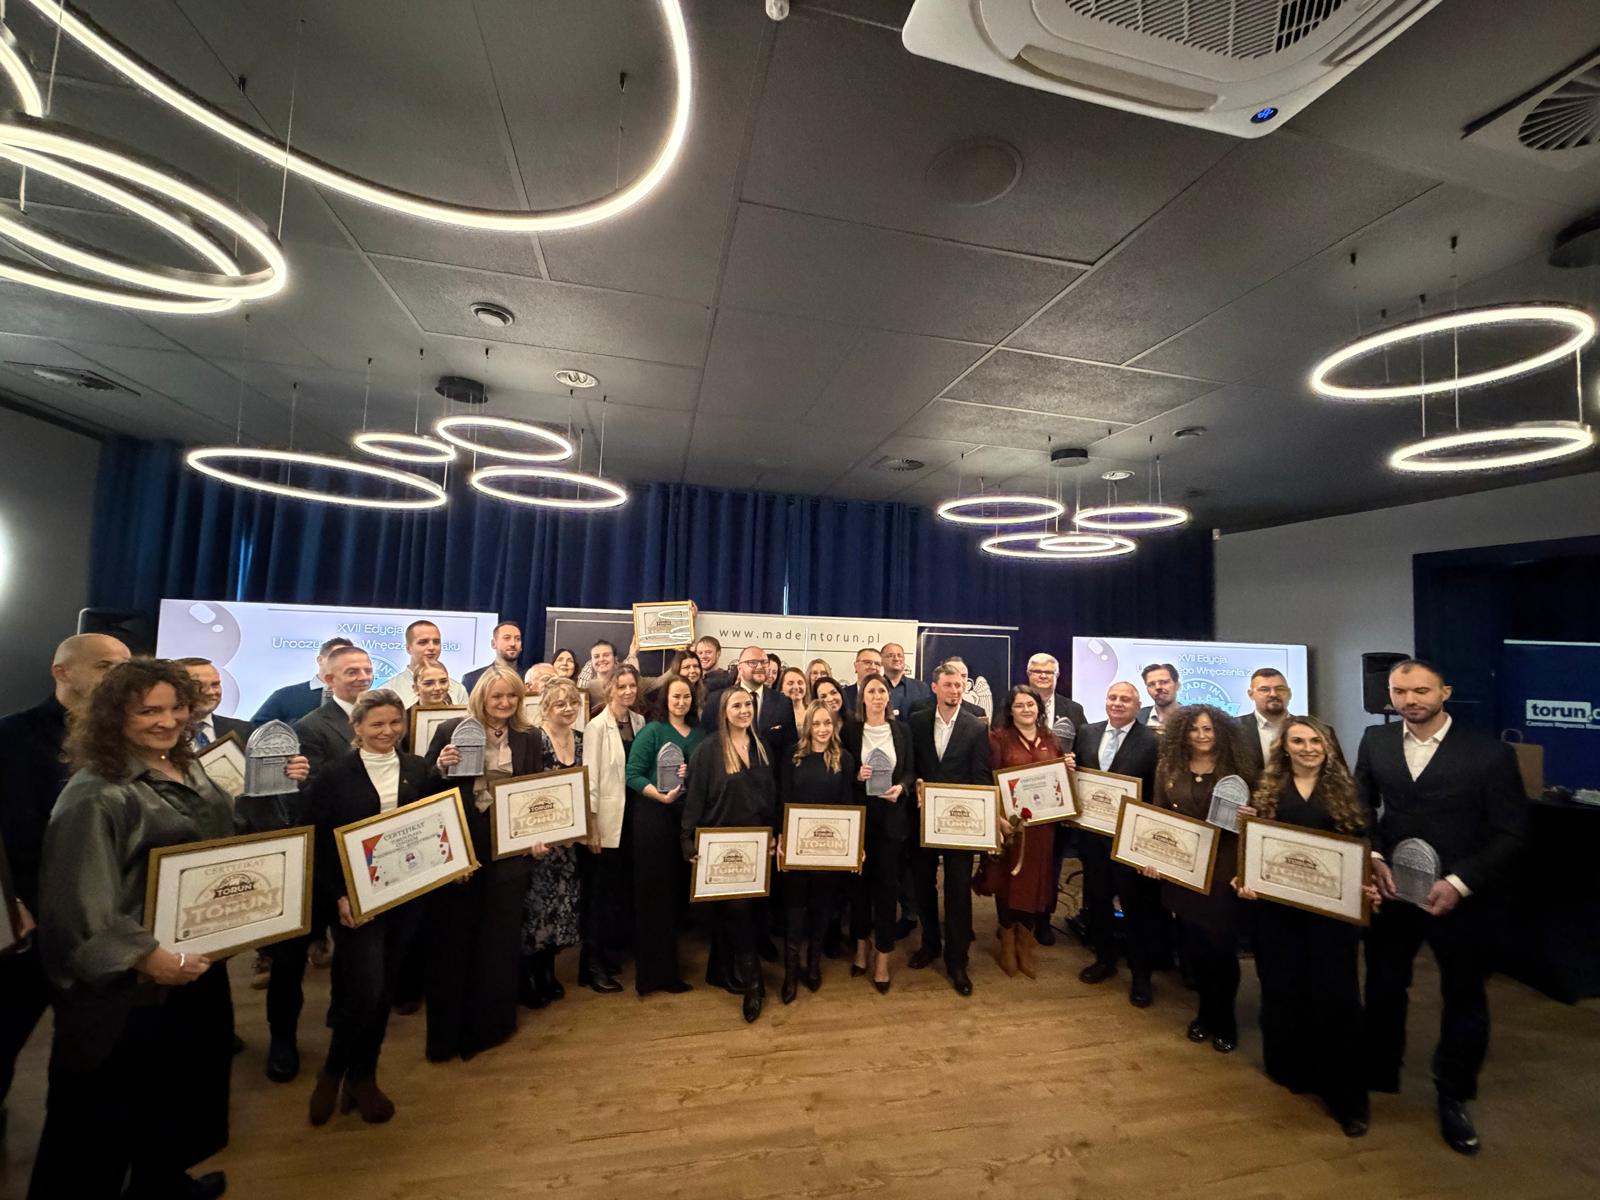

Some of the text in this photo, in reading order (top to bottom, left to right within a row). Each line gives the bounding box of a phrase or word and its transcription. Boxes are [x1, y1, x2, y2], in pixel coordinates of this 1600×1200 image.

[337, 623, 406, 636] XVII Edycja
[272, 637, 321, 651] Uroczy
[1197, 654, 1228, 665] Edycja
[217, 884, 252, 900] TORUN
